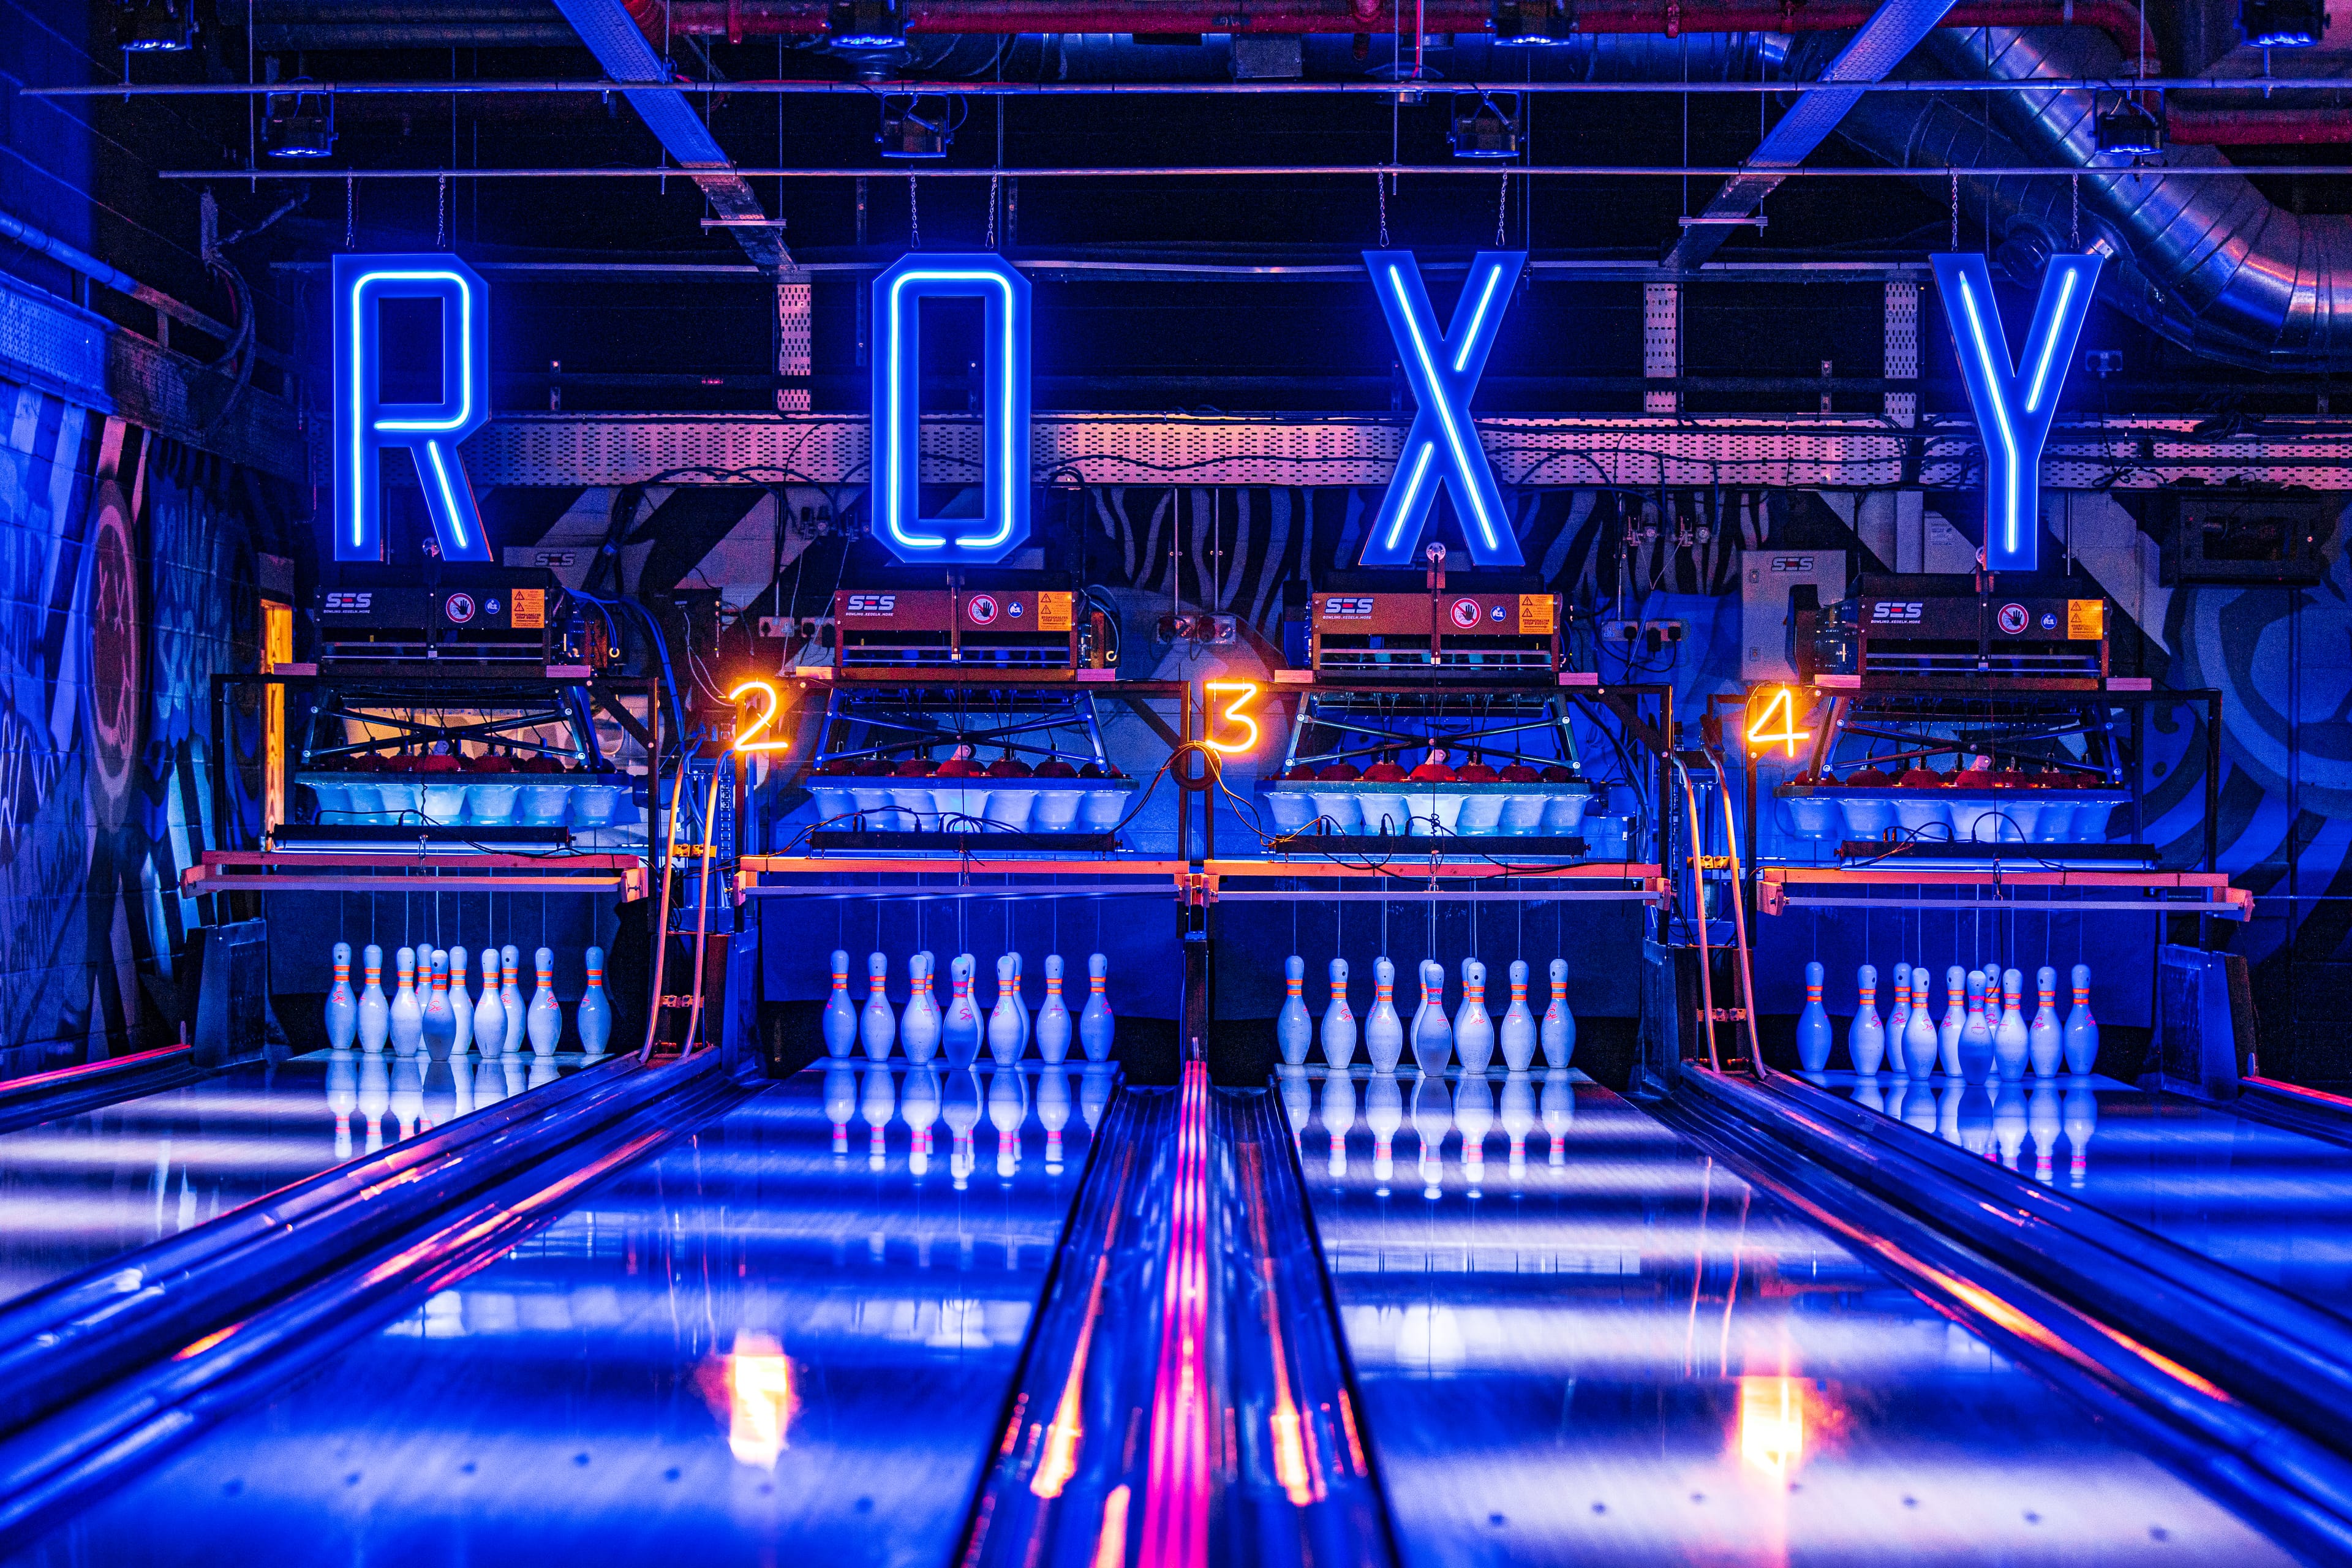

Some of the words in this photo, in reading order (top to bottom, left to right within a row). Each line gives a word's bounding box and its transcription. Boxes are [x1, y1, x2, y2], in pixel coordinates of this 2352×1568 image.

[533, 553, 576, 566] SES
[1771, 557, 1814, 571] SES
[325, 593, 372, 608] SES
[848, 595, 895, 611] SES
[1325, 598, 1374, 613] SES
[1873, 602, 1923, 618] SES
[729, 681, 788, 751] 2
[1206, 683, 1257, 753] 3
[1747, 688, 1810, 758] 4
